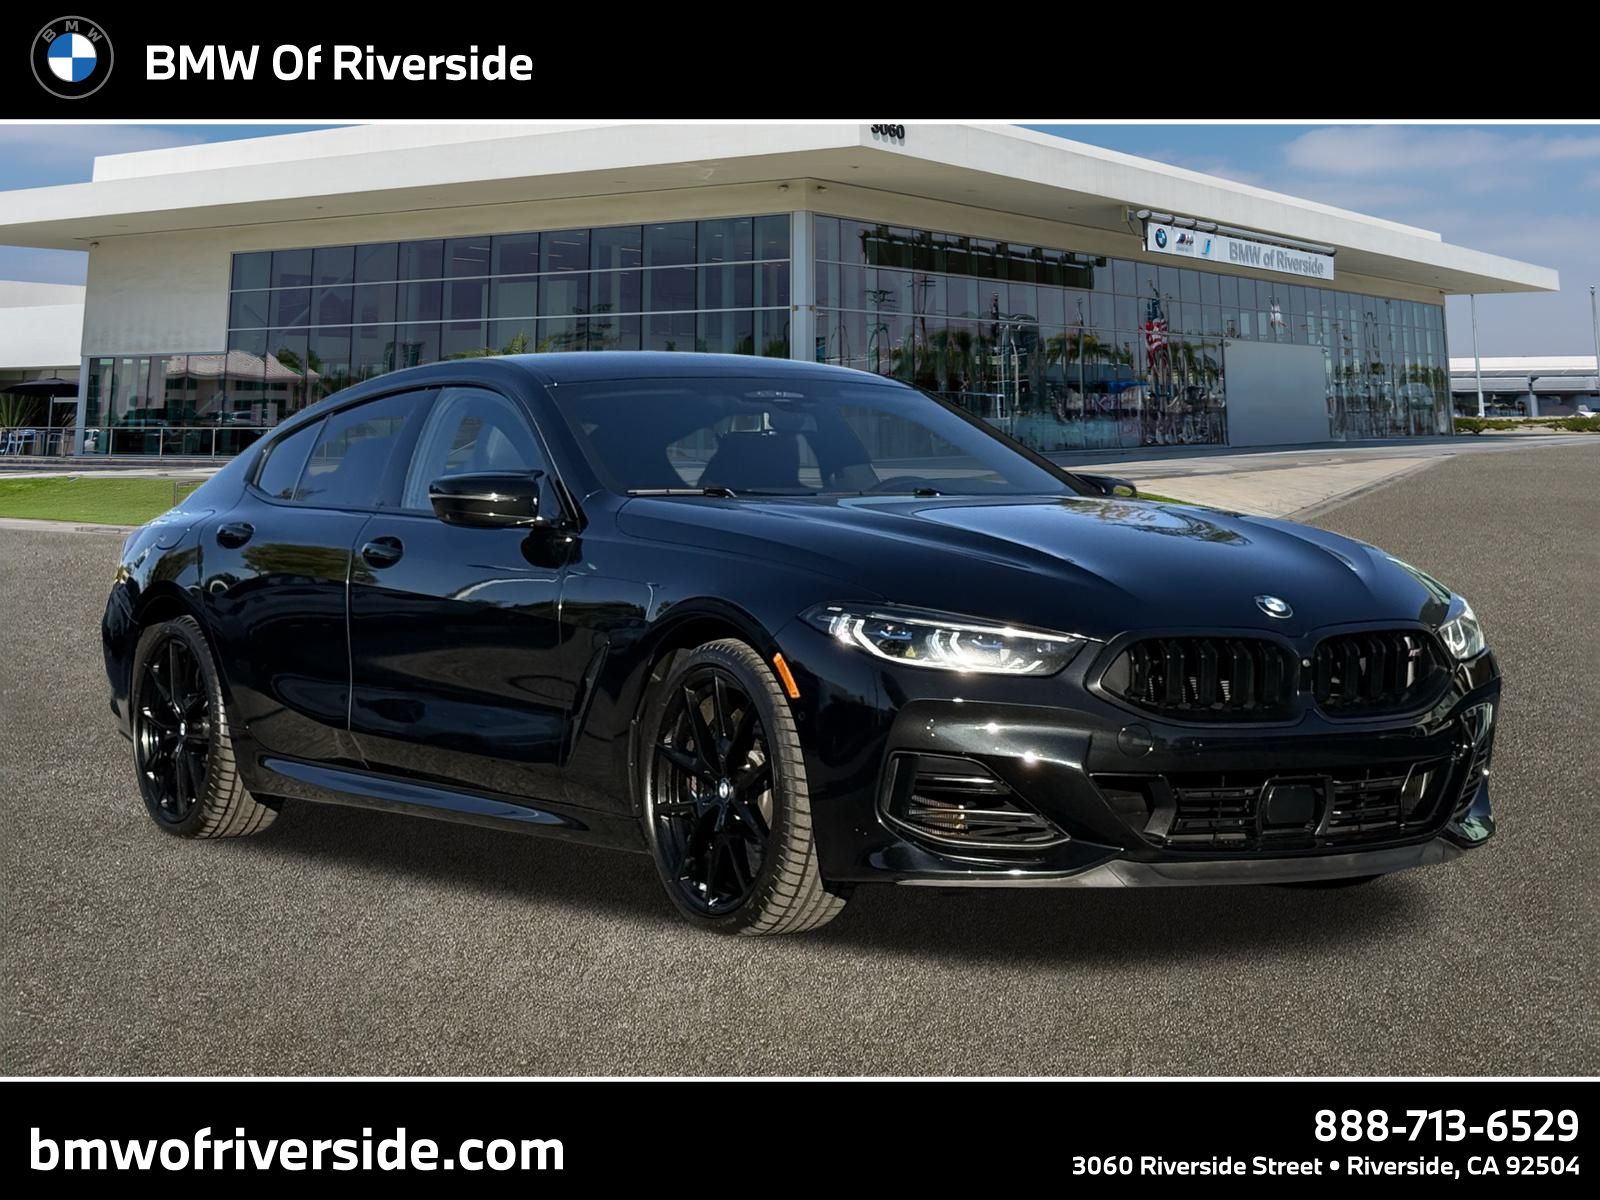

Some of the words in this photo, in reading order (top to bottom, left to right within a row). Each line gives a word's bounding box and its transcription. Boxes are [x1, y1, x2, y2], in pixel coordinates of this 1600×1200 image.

[1229, 242, 1260, 264] BMW
[1263, 249, 1275, 266] of
[1276, 251, 1324, 274] Riverside
